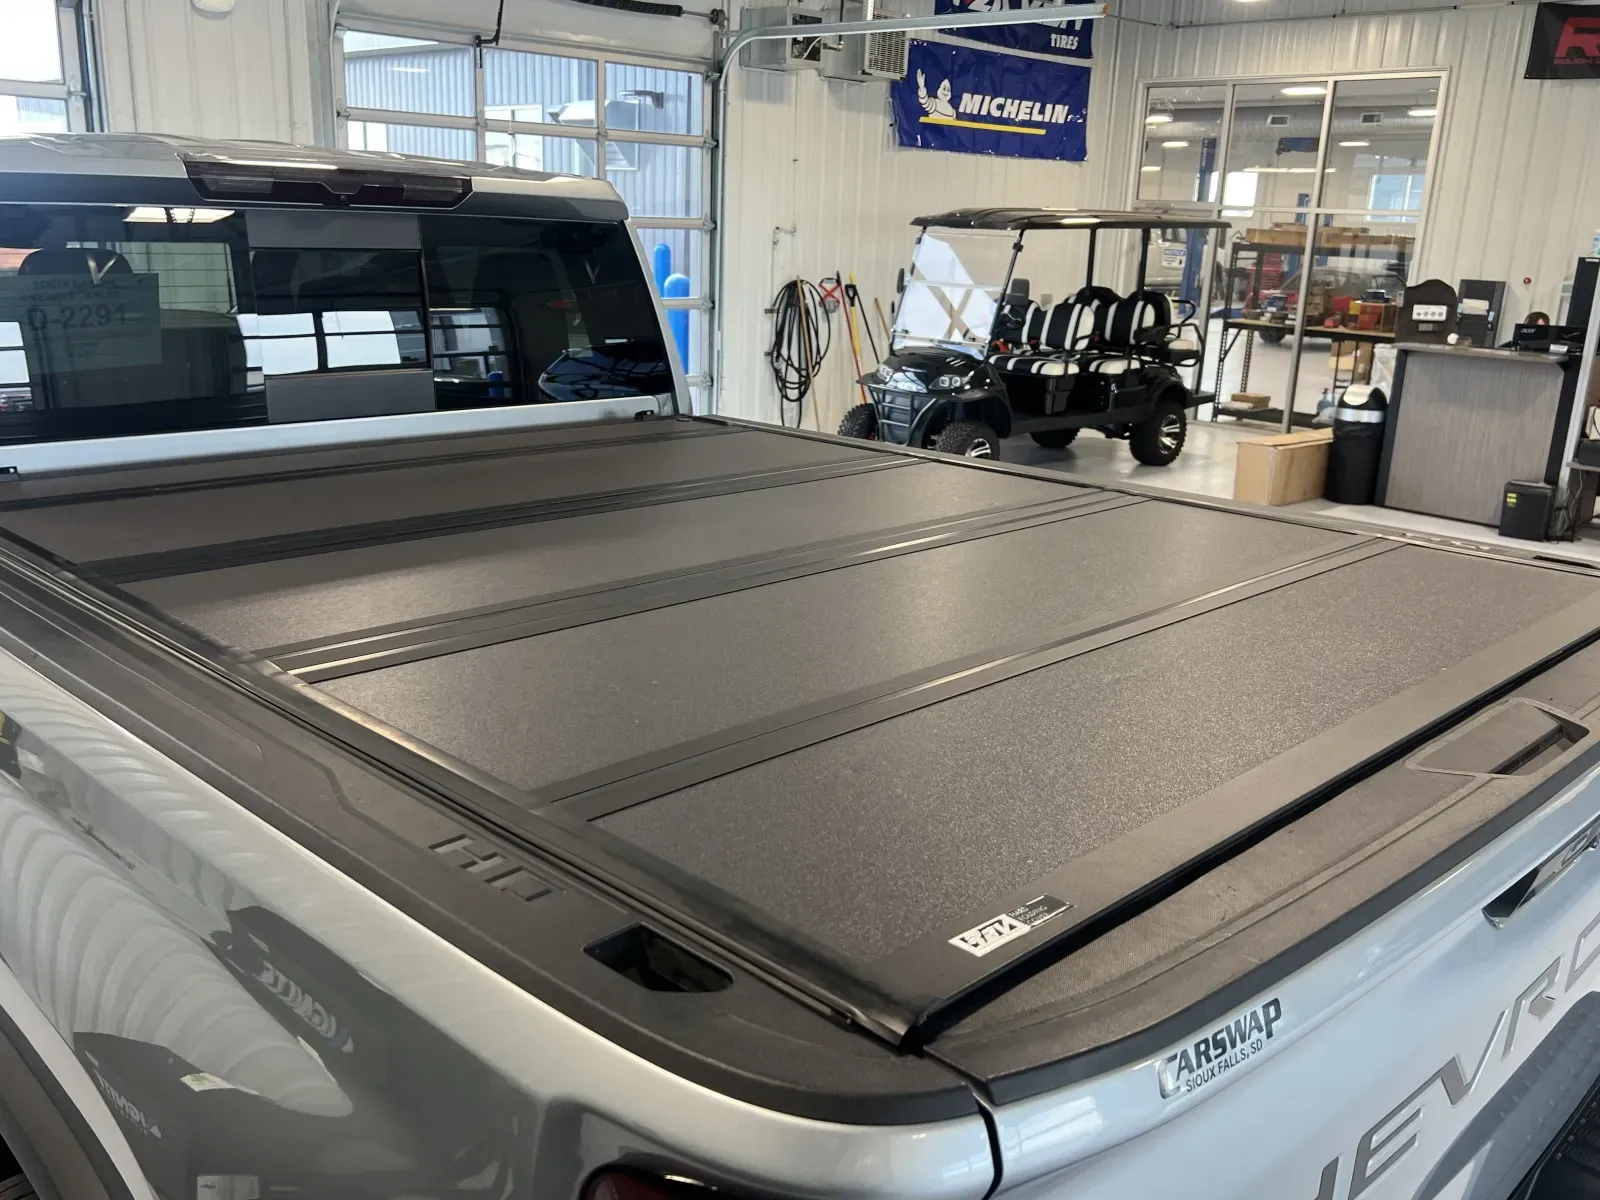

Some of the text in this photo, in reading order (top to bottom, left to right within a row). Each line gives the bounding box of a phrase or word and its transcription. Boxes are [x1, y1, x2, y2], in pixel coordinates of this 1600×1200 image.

[1050, 33, 1079, 50] TIRES
[958, 92, 1069, 124] MICHELIN
[1157, 997, 1282, 1100] CARSWAP
[1185, 1038, 1263, 1093] SIOUX FALLS, SD
